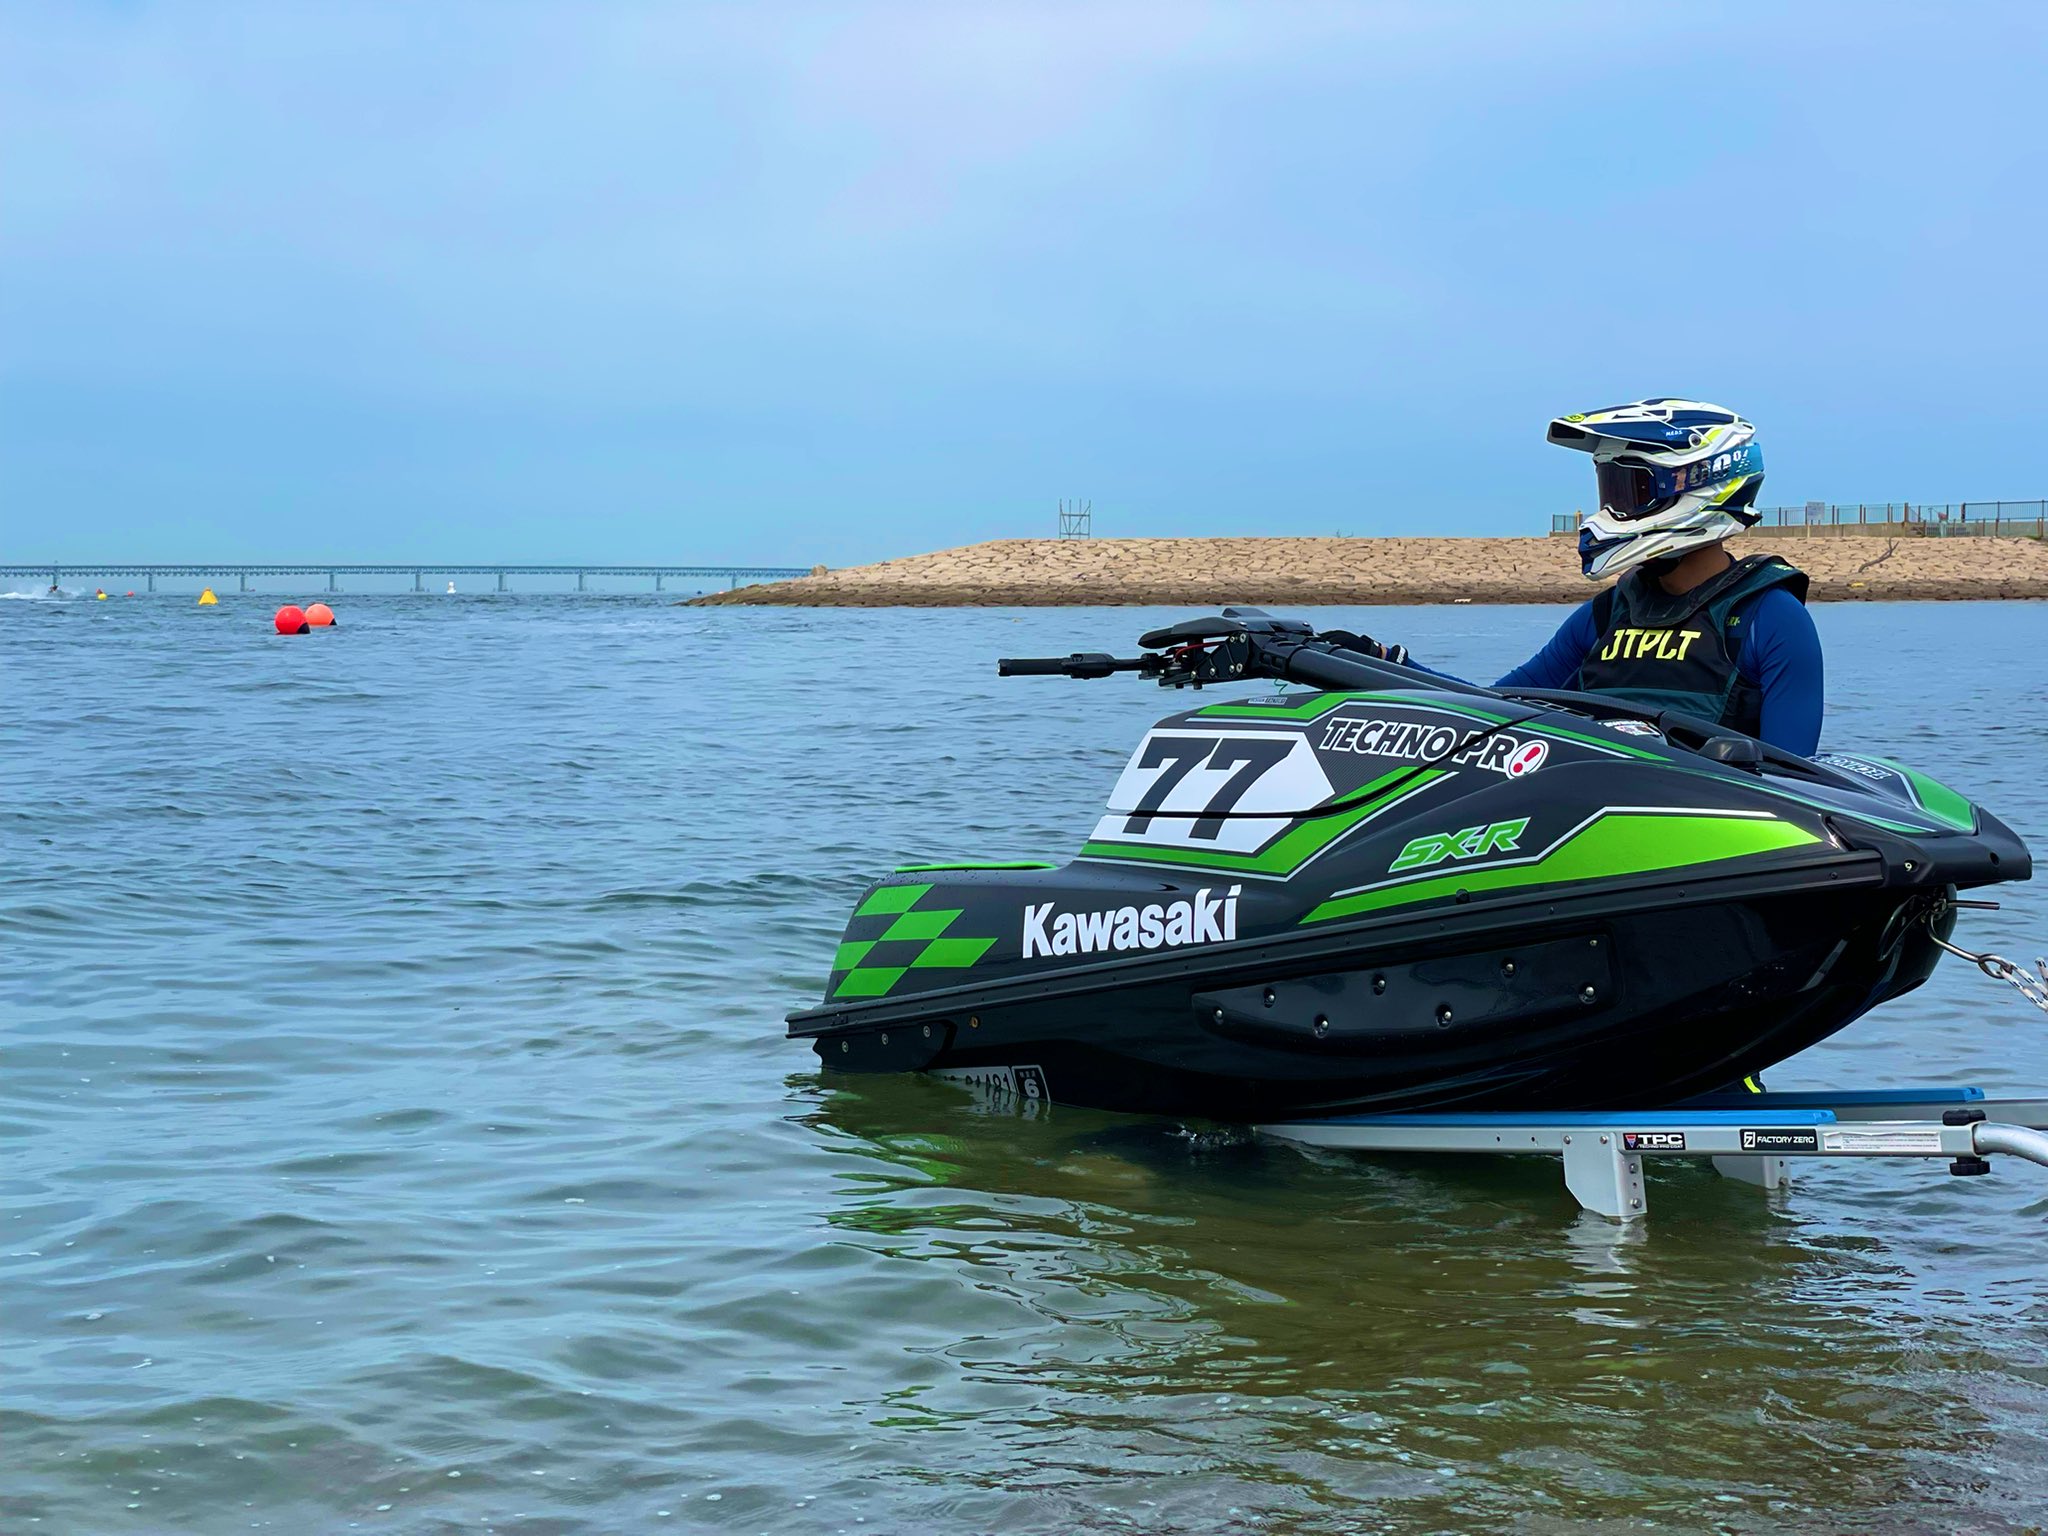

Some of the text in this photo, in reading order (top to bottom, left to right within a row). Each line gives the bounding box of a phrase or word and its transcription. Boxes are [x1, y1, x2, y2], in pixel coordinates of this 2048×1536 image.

[1672, 448, 1752, 492] 100%
[1601, 628, 1702, 661] JTPLT
[1319, 716, 1457, 762] TECHNO
[1122, 736, 1298, 841] 77
[1387, 816, 1532, 874] SX-R
[1022, 884, 1242, 959] Kawasaki
[1024, 1078, 1040, 1098] 6
[1637, 1134, 1684, 1145] TPC
[1756, 1136, 1815, 1144] FACTORY ZERO
